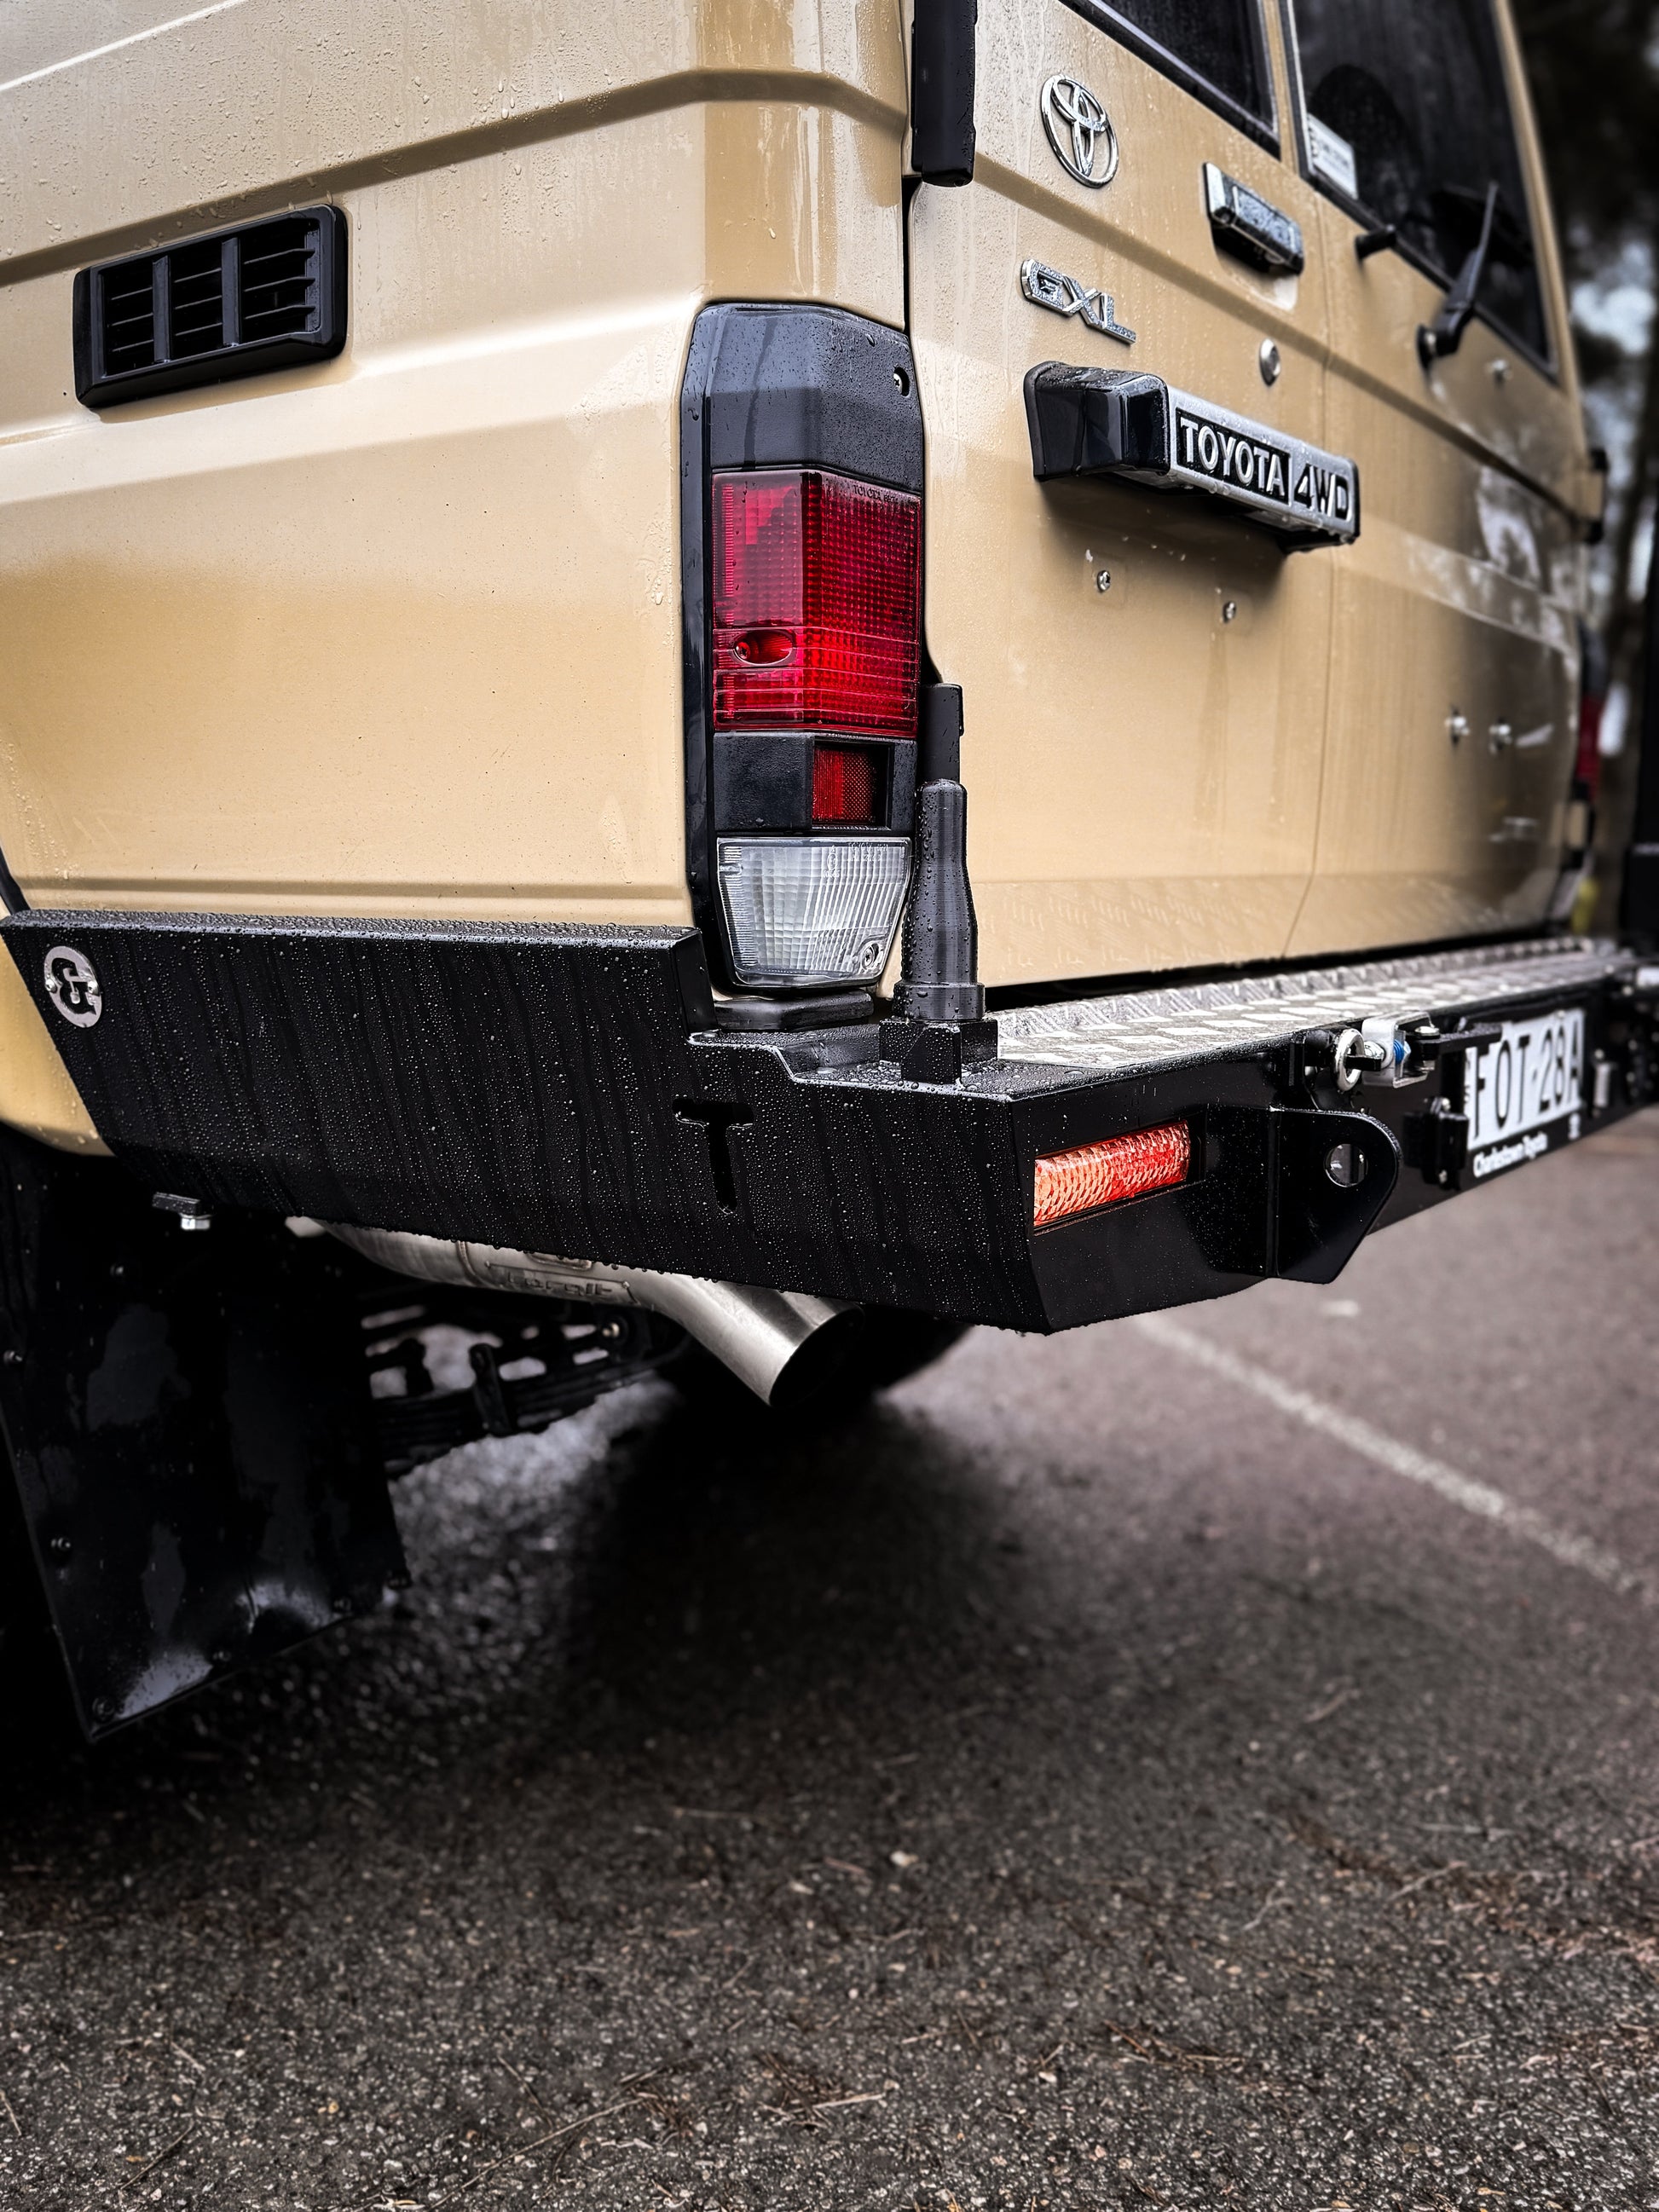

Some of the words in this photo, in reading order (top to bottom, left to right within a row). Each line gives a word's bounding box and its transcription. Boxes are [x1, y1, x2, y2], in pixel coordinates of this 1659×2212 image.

[1020, 258, 1136, 344] GXL
[1180, 416, 1286, 498] TOYOTA
[1293, 463, 1350, 522] 4WD
